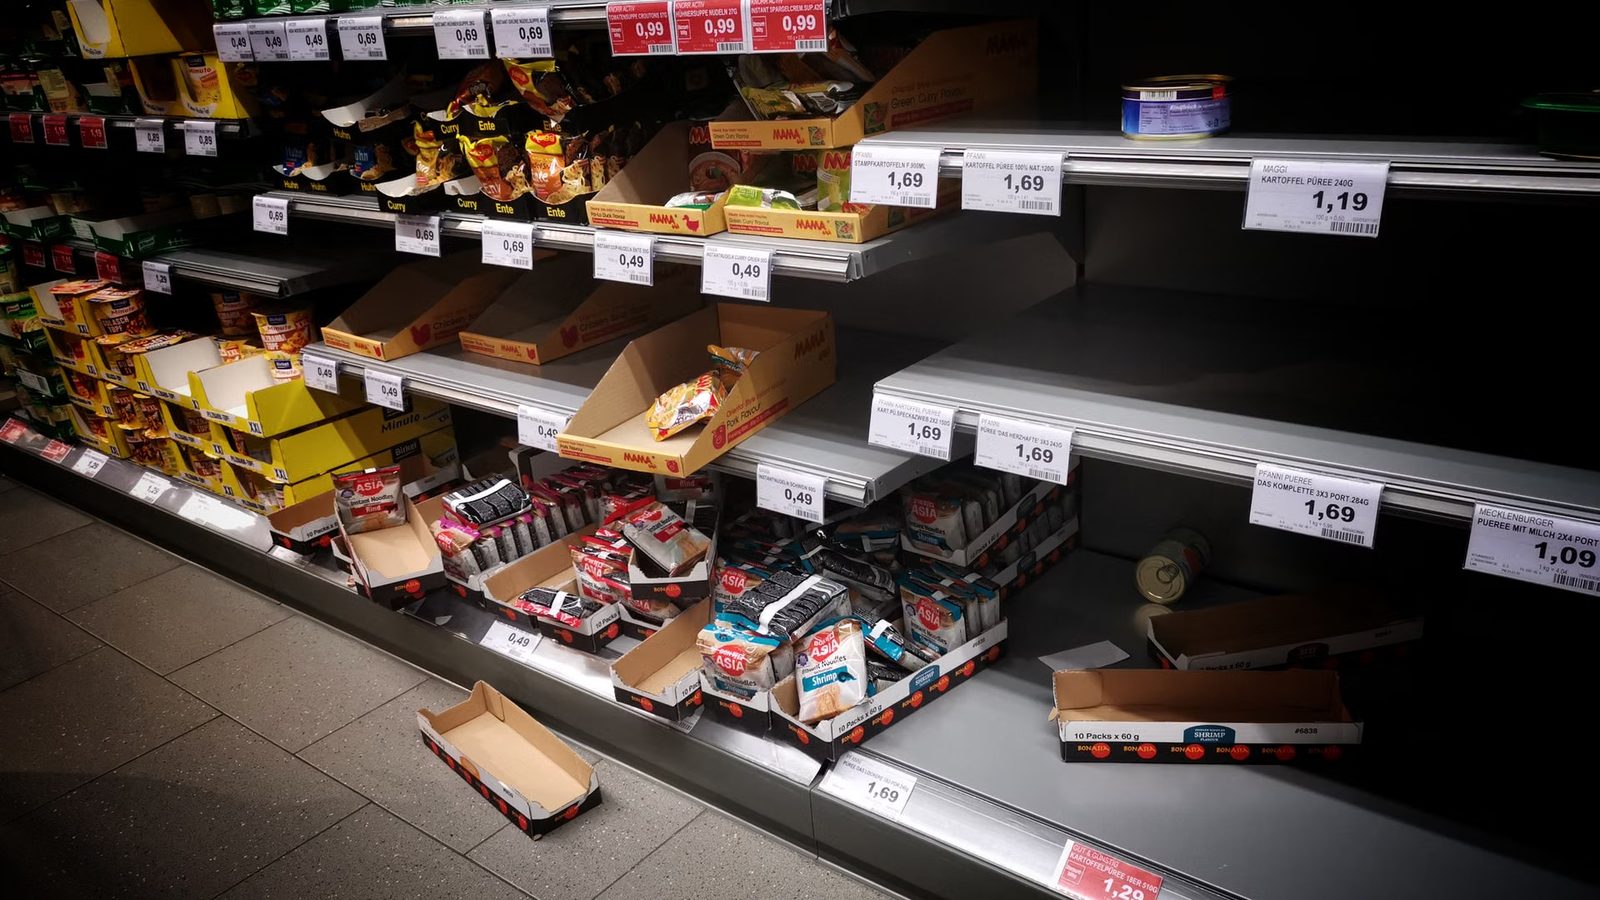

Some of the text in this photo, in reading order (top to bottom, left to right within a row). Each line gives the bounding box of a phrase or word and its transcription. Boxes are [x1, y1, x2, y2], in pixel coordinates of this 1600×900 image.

[636, 22, 664, 39] 0,99
[704, 18, 735, 37] 0,99
[782, 14, 816, 34] 0,99
[306, 34, 323, 47] 0,49
[358, 33, 377, 46] 0,69
[456, 29, 478, 44] 0,69
[519, 26, 543, 42] 0,69
[231, 37, 246, 49] 0,49
[266, 36, 282, 49] 0,49
[892, 92, 937, 110] Green Curry
[440, 124, 459, 134] Curry
[478, 120, 496, 131] Ente
[148, 133, 160, 143] 0,89
[199, 136, 212, 146] 0,89
[334, 129, 351, 140] Huhn
[773, 129, 801, 140] MAMA
[854, 160, 905, 169] STAMPFKARTOFFELN
[996, 162, 1014, 170] PÜREE
[1029, 164, 1054, 172] NAT.120G
[1263, 165, 1288, 174] MAGGI
[284, 180, 299, 190] Huhn
[310, 181, 327, 192] Huhn
[888, 172, 923, 189] 1,69
[1004, 174, 1044, 193] 1,69
[1262, 175, 1353, 188] KARTOFFEL PÜREE 240G
[387, 200, 405, 212] Curry
[457, 198, 477, 210] Curry
[1312, 190, 1368, 213] 1,19
[496, 203, 514, 214] Ente
[547, 207, 566, 218] Ente
[269, 210, 283, 222] 0,69
[649, 213, 675, 224] MAMA
[796, 219, 827, 230] MAMA
[416, 229, 434, 242] 0,69
[503, 240, 524, 253] 0,69
[619, 254, 644, 268] 0,49
[732, 263, 760, 279] 0,49
[156, 274, 167, 283] 1,29
[433, 318, 464, 330] Chicken
[317, 367, 332, 378] 0,49
[381, 384, 398, 397] 0,49
[726, 403, 761, 428] Pork Flavour
[939, 418, 950, 426] 150G
[248, 422, 262, 434] XXL
[538, 425, 558, 438] 0,49
[908, 422, 941, 441] 1,69
[274, 449, 288, 460] XXL
[624, 453, 651, 464] MAMA
[1015, 444, 1053, 463] 1,69
[1258, 470, 1313, 486] PFANNI PUEREE
[356, 480, 384, 492] ASIA
[1257, 479, 1369, 506] DAS KOMPLETTE 3X3 PORT.284G
[350, 494, 393, 506] Instant Noodles
[785, 489, 812, 505] 0,49
[365, 505, 381, 513] Rind
[912, 504, 937, 518] ASIA
[1304, 499, 1355, 522] 1,69
[1479, 508, 1554, 528] MECKLENBURGER
[1477, 518, 1599, 547] PUEREE MIT MILCH 2X4 PORT
[1534, 541, 1596, 568] 1,09
[721, 575, 745, 588] ASIA
[918, 608, 940, 625] ASIA
[508, 632, 530, 647] 0,49
[810, 640, 839, 658] ASIA
[715, 657, 744, 671] ASIA
[812, 671, 837, 686] Shrimp
[839, 724, 845, 733] 10
[846, 714, 864, 728] Packs
[870, 707, 877, 716] 60
[878, 705, 882, 713] g
[868, 781, 899, 802] 1,69
[1072, 845, 1086, 854] GUT
[1070, 852, 1125, 879] KARTOFFELPÜREE
[1126, 875, 1141, 885] 18ER
[1142, 881, 1158, 893] 510G
[1104, 878, 1144, 900] 1,29
